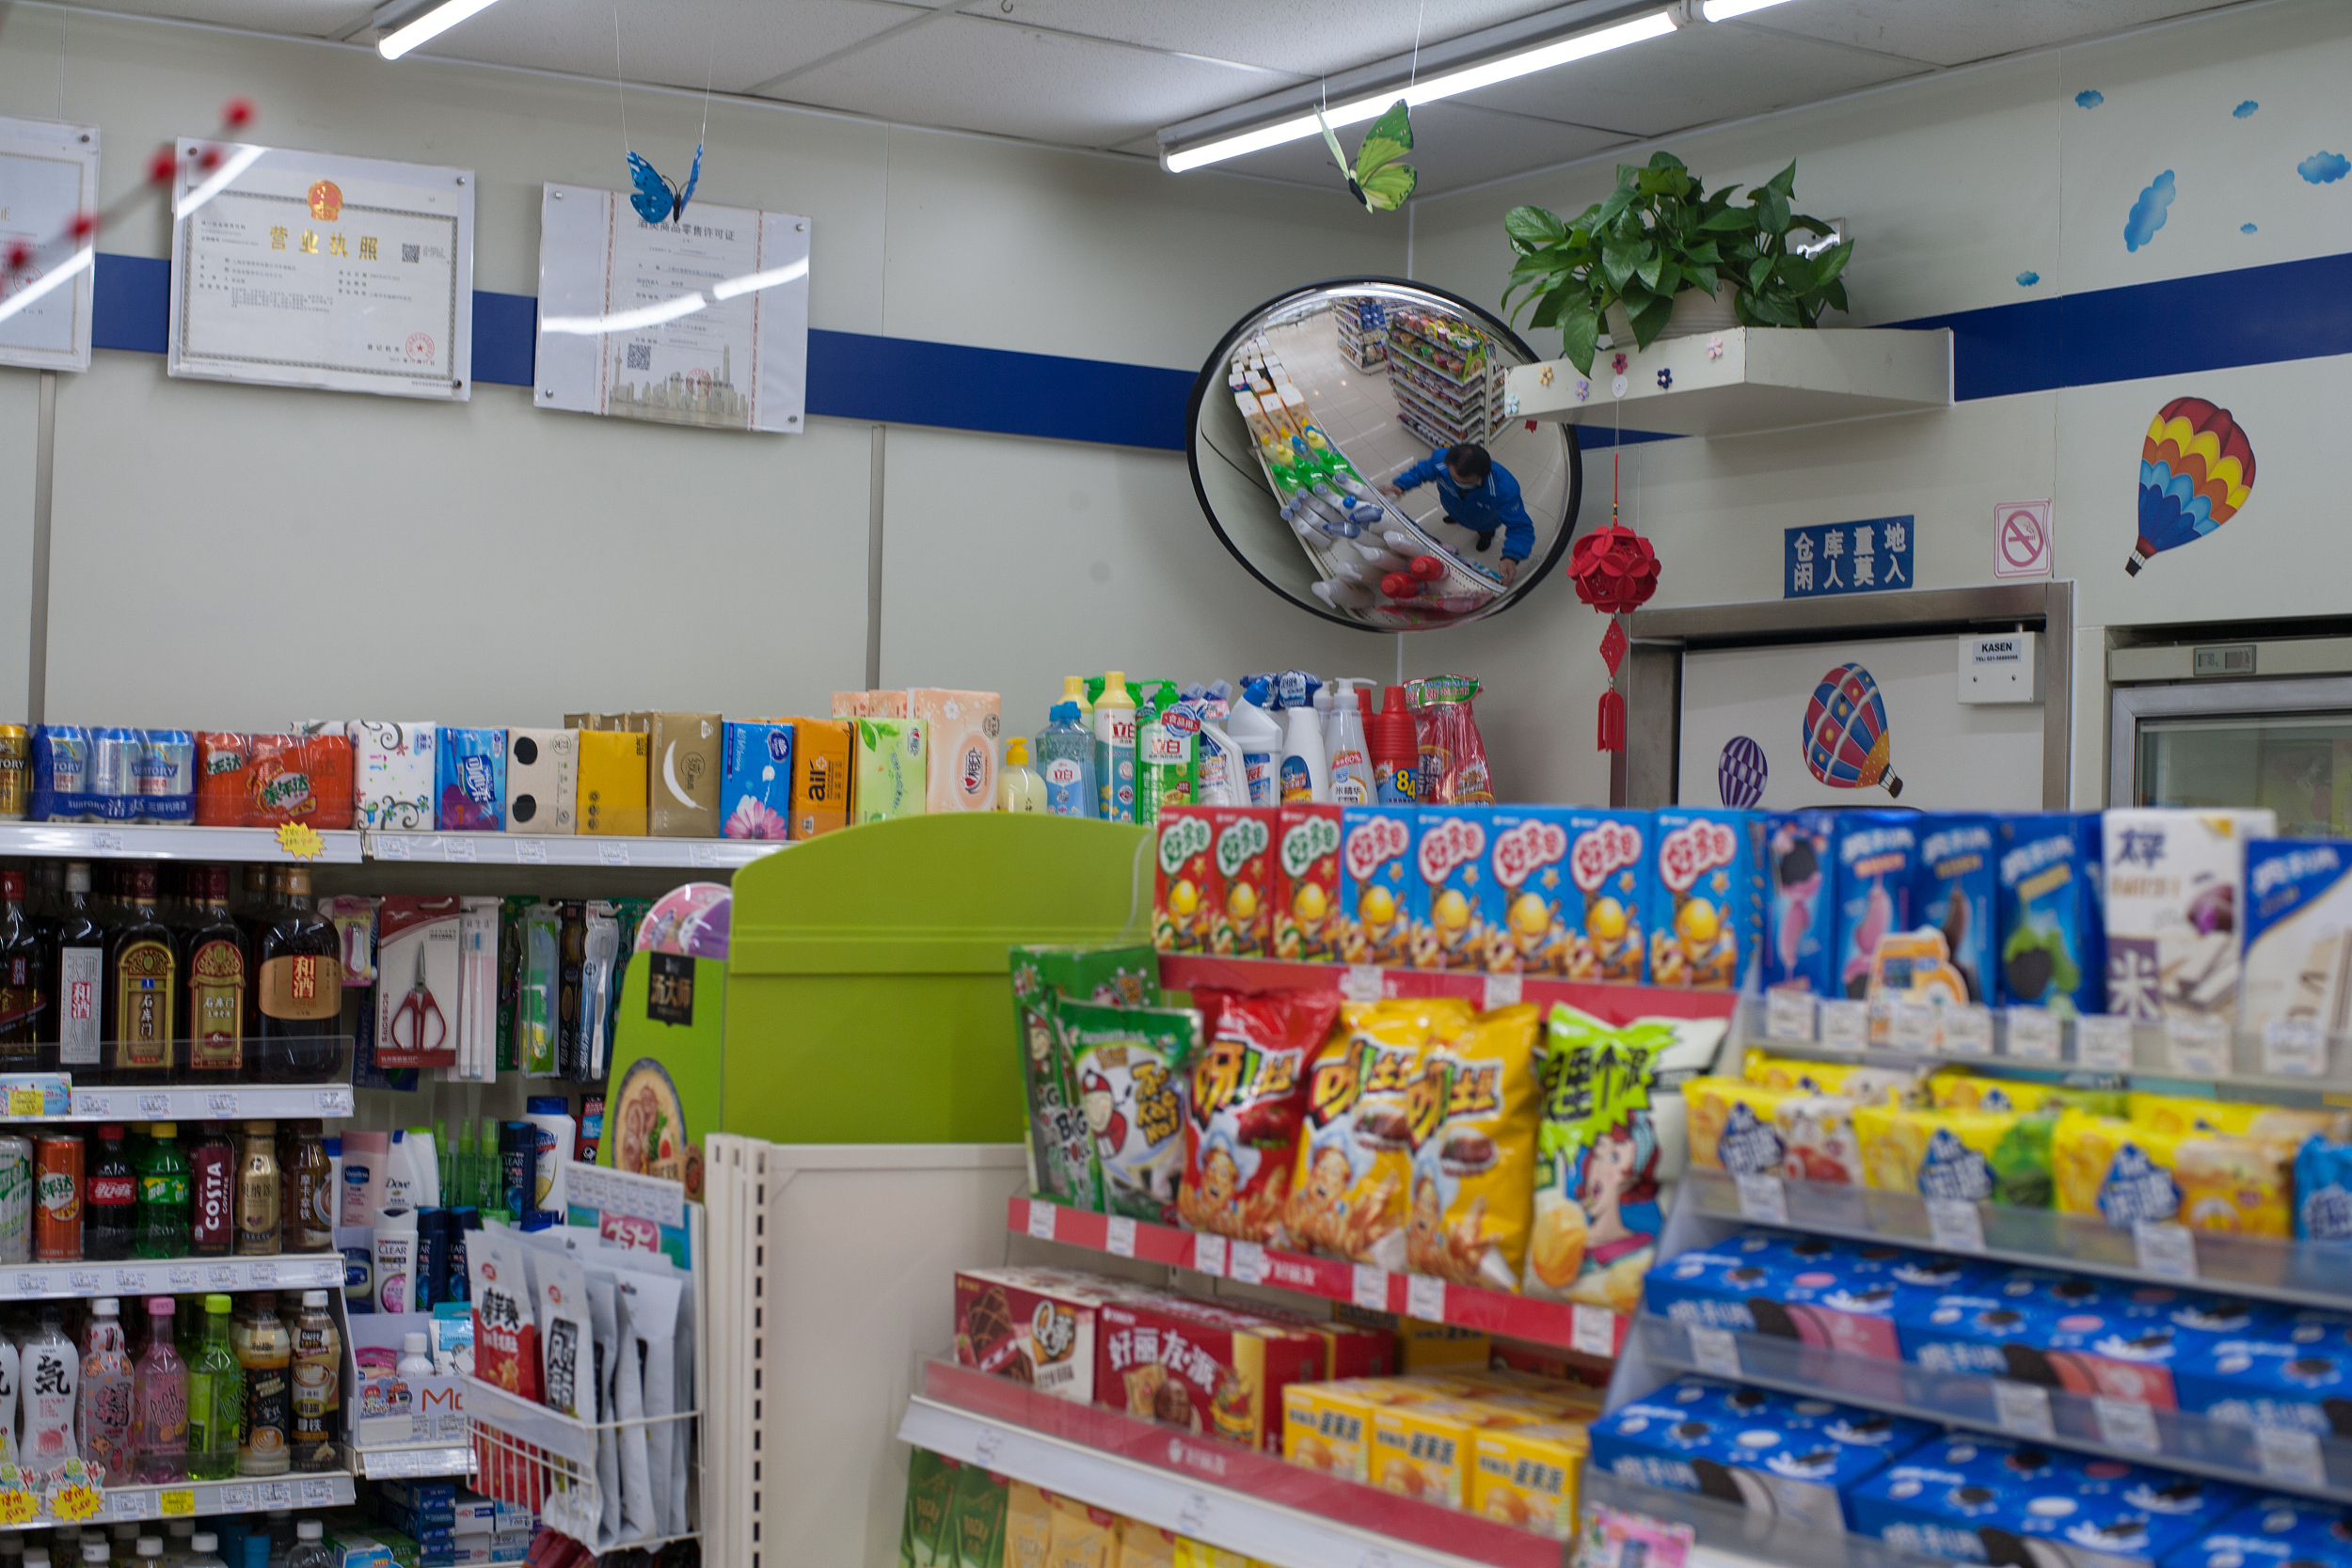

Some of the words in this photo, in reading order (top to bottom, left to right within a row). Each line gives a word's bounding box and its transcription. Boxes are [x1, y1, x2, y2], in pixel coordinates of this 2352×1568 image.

[270, 225, 378, 261] 营业执照
[1794, 522, 1906, 562] 仓库重地
[1793, 554, 1906, 592] 闲人莫入
[1981, 641, 2012, 653] KASEN
[1152, 739, 1181, 754] 立白
[0, 758, 25, 769] TORY
[54, 763, 81, 772] TORY
[1054, 769, 1073, 780] 立白
[262, 773, 310, 806] 美年达
[1396, 769, 1417, 800] 84
[68, 800, 105, 811] SUNTORY
[294, 955, 315, 998] 和酒
[72, 982, 91, 1019] 和酒
[203, 996, 235, 1009] 石库门
[140, 994, 153, 1037] 石库门
[241, 1183, 273, 1199] 贝纳颂
[386, 1178, 411, 1190] Dove
[205, 1161, 222, 1231] COSTA
[300, 1173, 311, 1222] 摩卡拿铁
[378, 1244, 407, 1256] CLEAR
